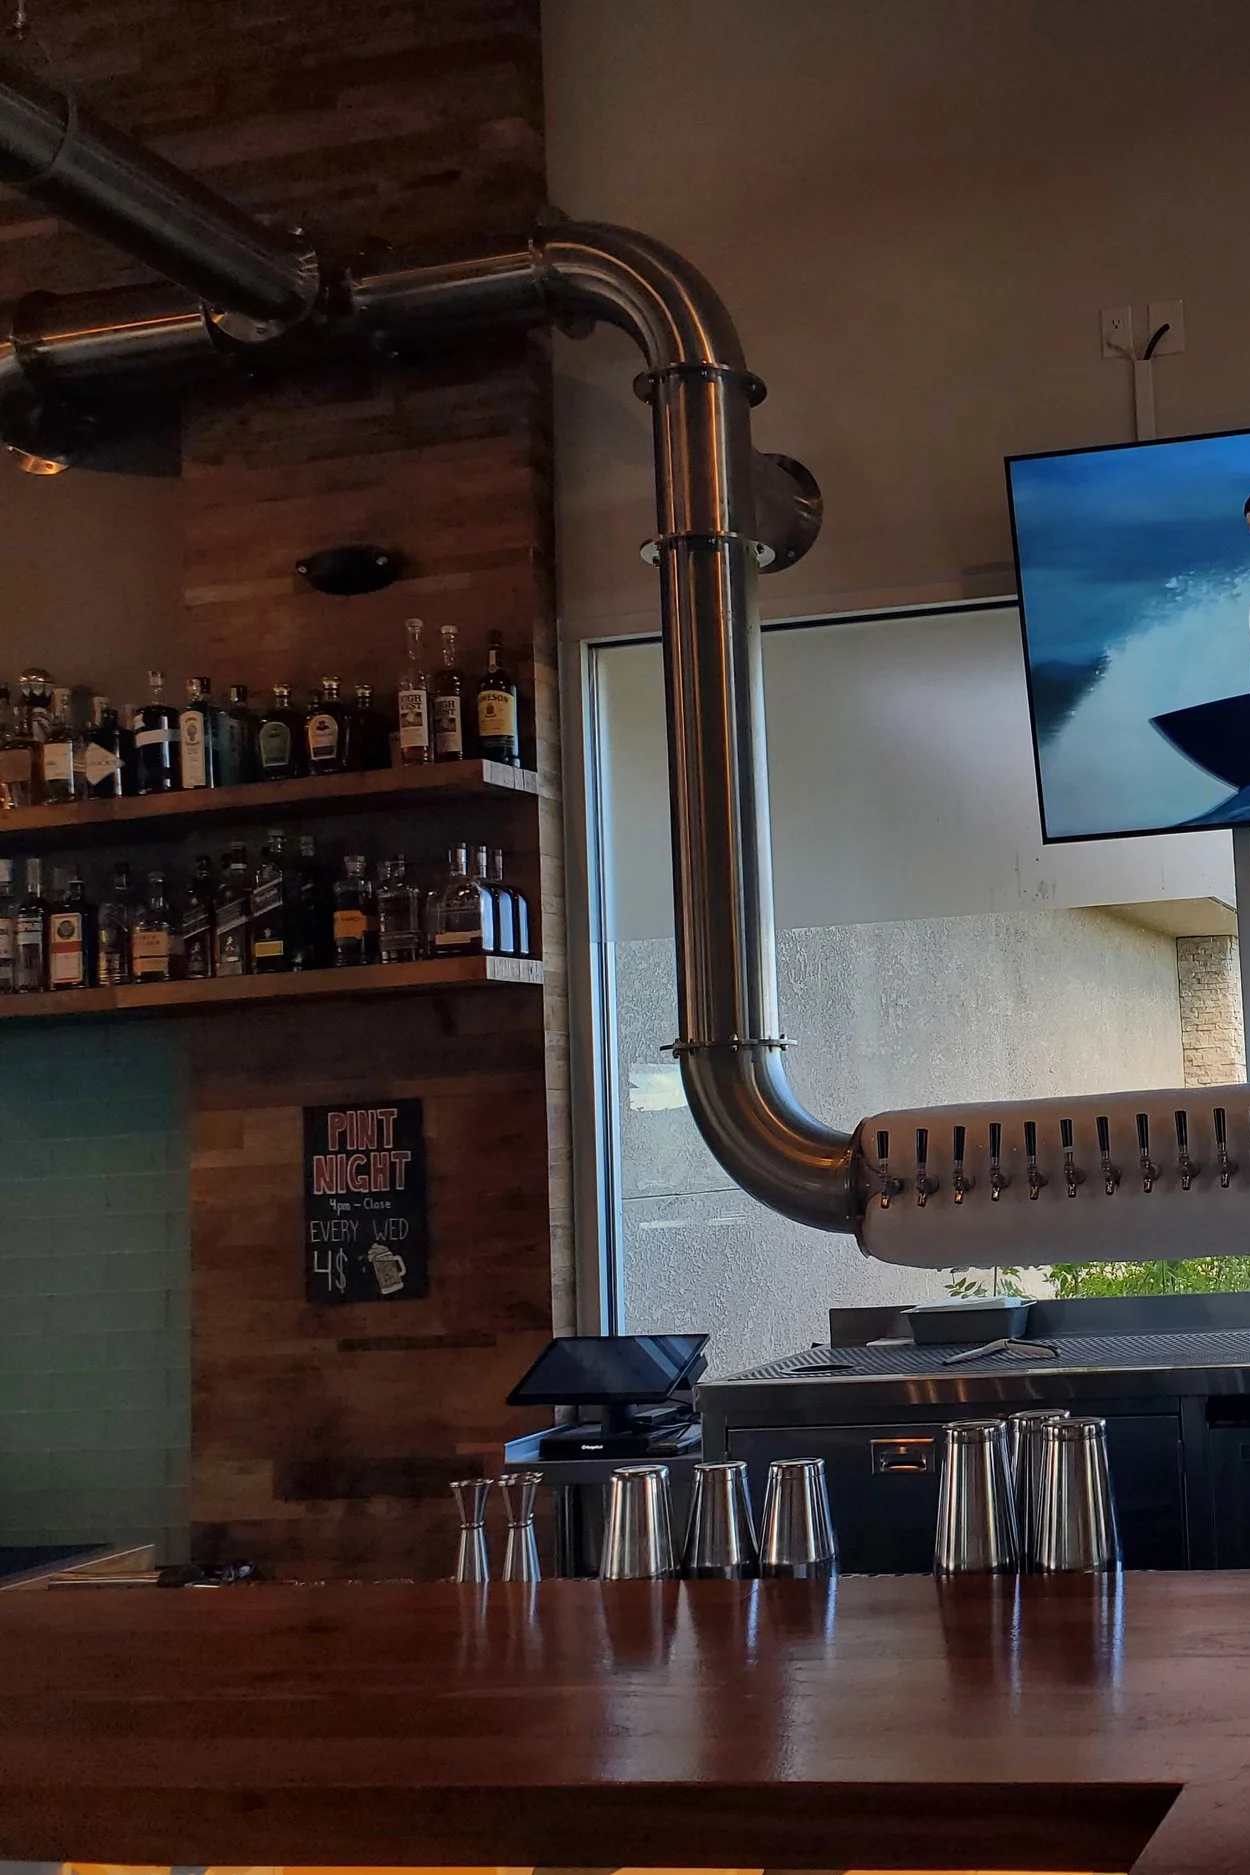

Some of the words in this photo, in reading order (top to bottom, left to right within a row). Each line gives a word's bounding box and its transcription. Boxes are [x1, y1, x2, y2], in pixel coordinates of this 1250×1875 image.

[327, 1108, 398, 1151] PINT
[313, 1151, 411, 1195] NIGHT
[329, 1199, 351, 1216] 4pm
[363, 1198, 392, 1210] Close
[310, 1219, 359, 1242] EVERY
[373, 1218, 409, 1241] WED
[314, 1248, 348, 1294] 4$
